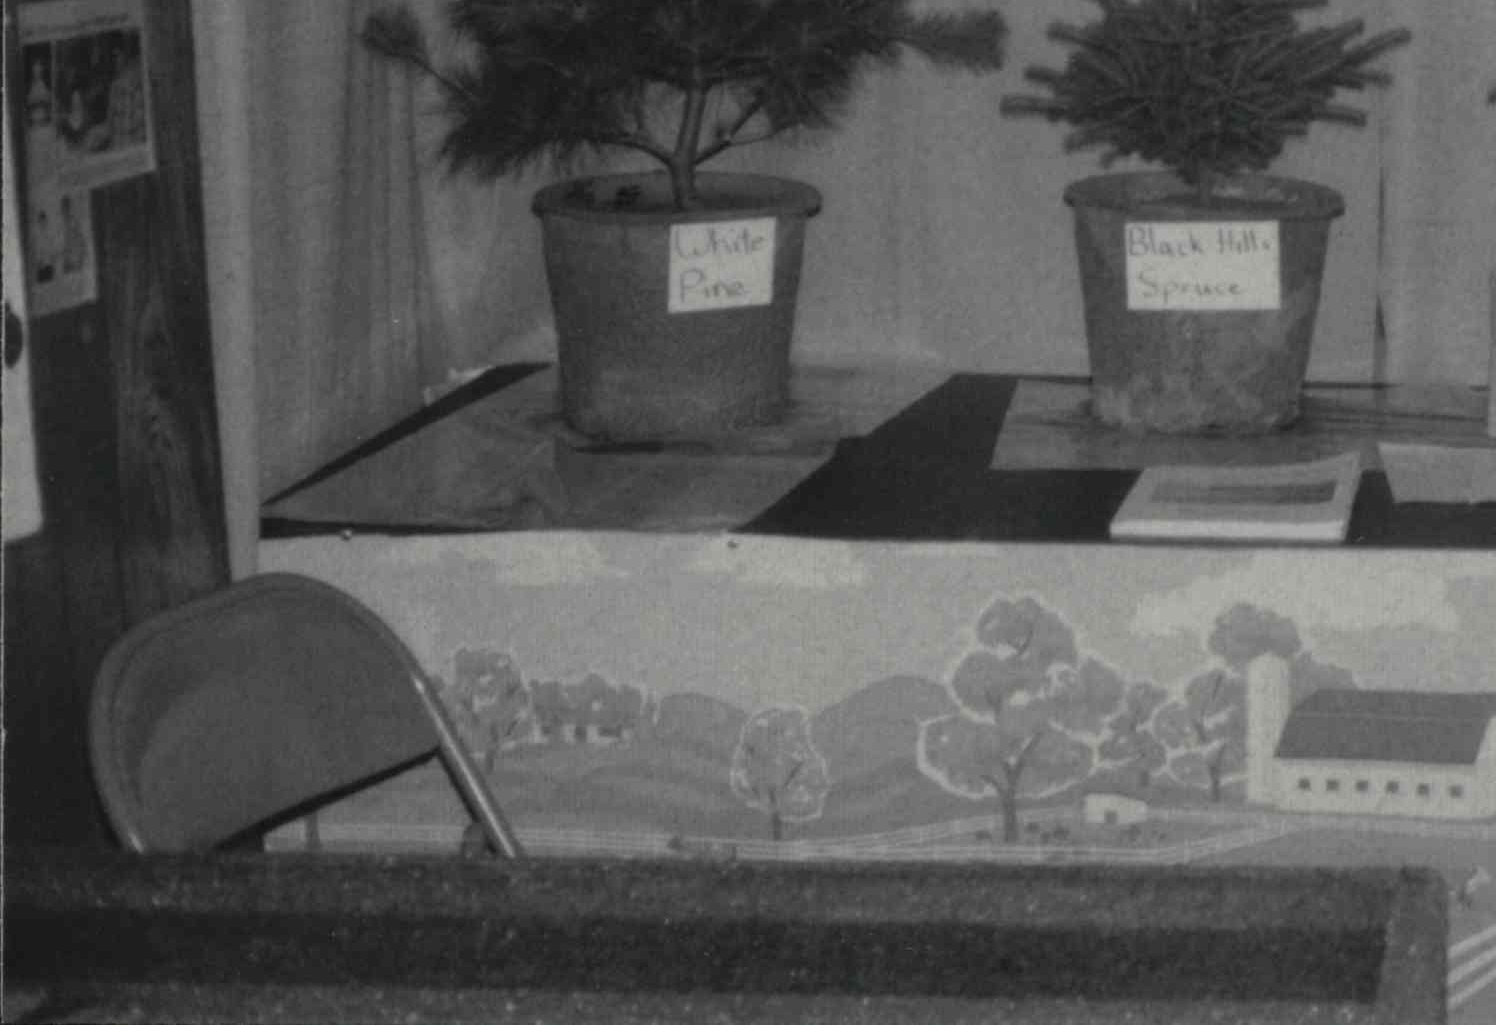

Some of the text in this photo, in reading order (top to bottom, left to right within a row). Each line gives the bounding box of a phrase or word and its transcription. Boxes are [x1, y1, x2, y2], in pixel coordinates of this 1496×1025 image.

[673, 225, 766, 259] White
[1128, 226, 1272, 257] Black Hills
[680, 268, 746, 303] Pine
[1138, 270, 1243, 304] Spruce
